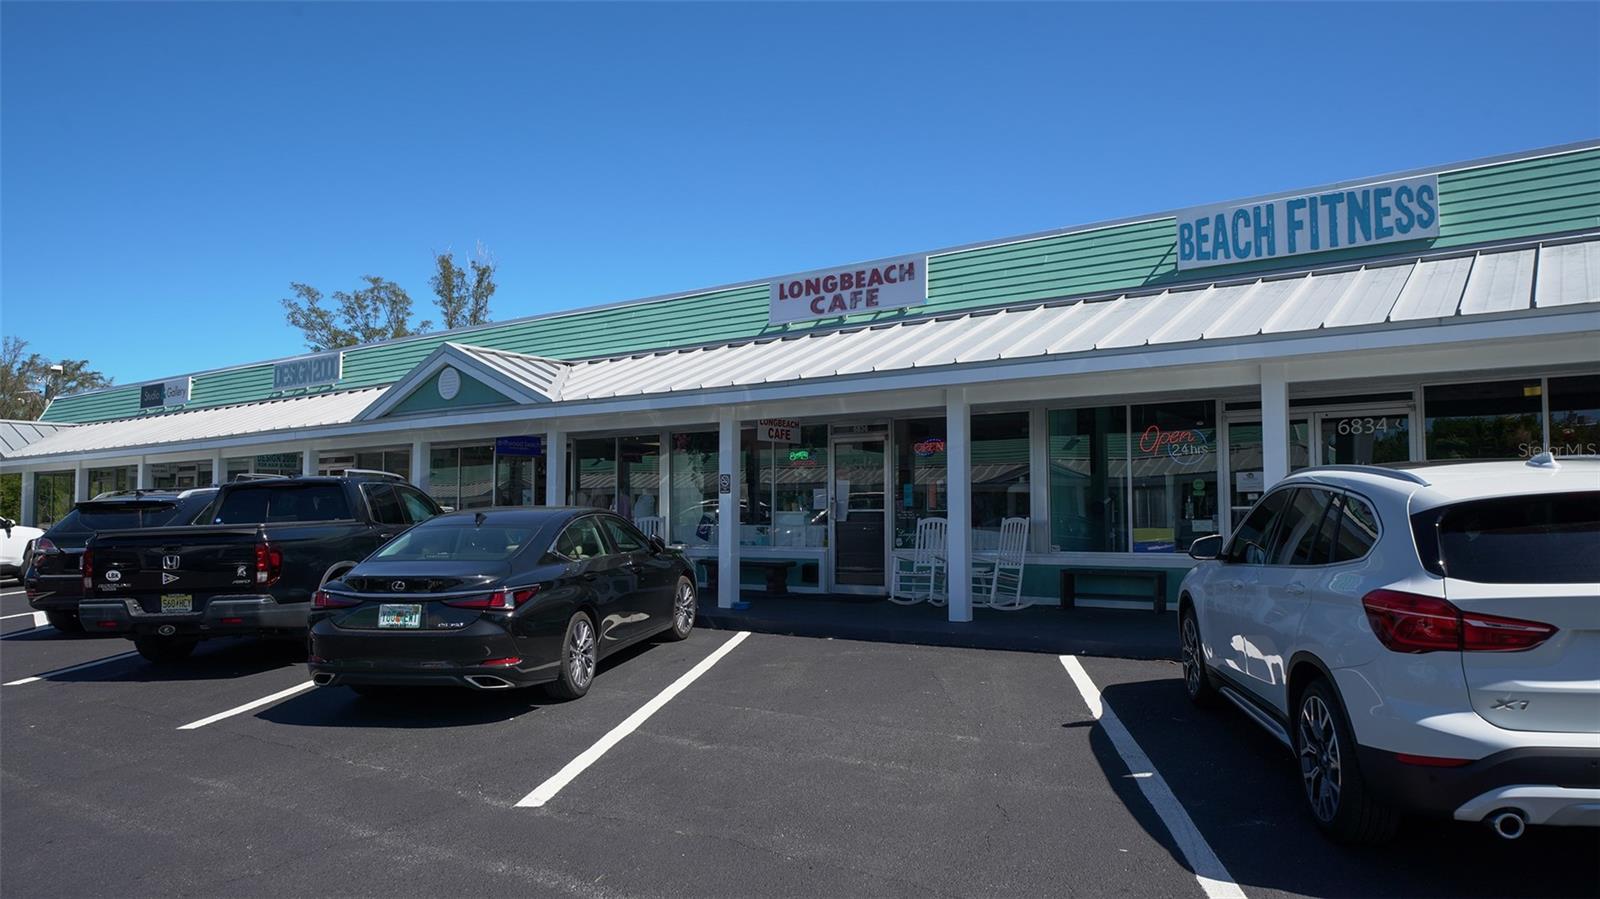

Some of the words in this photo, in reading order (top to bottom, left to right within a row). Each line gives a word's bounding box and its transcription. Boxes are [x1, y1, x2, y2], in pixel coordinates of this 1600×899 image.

[1179, 203, 1276, 261] BEACH
[1286, 184, 1435, 254] FITNESS
[779, 262, 915, 300] LONGBEACH
[810, 288, 879, 315] CAFE
[166, 384, 186, 400] Gallery
[759, 419, 800, 429] LONGBEACH
[1338, 417, 1387, 435] 6834
[767, 428, 792, 441] CAFE
[1140, 424, 1196, 457] Open
[914, 441, 945, 453] OPEN
[1490, 699, 1530, 712] X1
